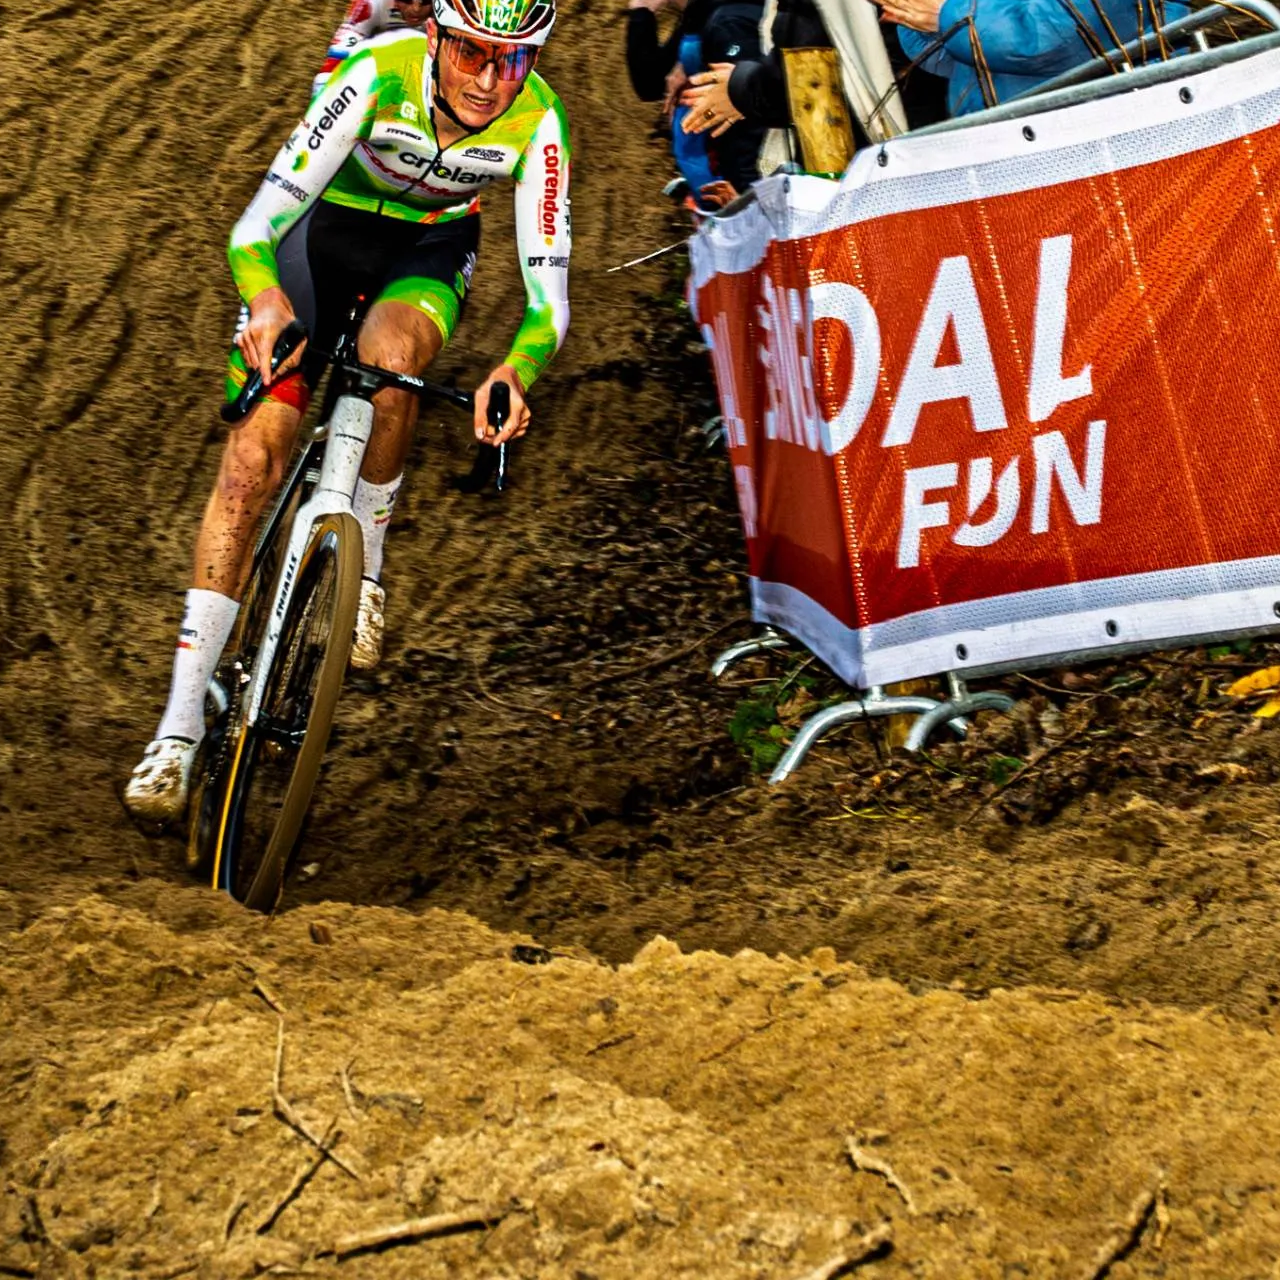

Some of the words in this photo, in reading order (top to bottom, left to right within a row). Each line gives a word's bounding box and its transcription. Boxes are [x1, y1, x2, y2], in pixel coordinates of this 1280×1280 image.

[308, 85, 358, 151] crelan
[279, 179, 310, 203] SWISS
[398, 151, 495, 185] crelan
[543, 143, 559, 236] corendon
[528, 257, 546, 267] DT
[896, 420, 1108, 568] FUN
